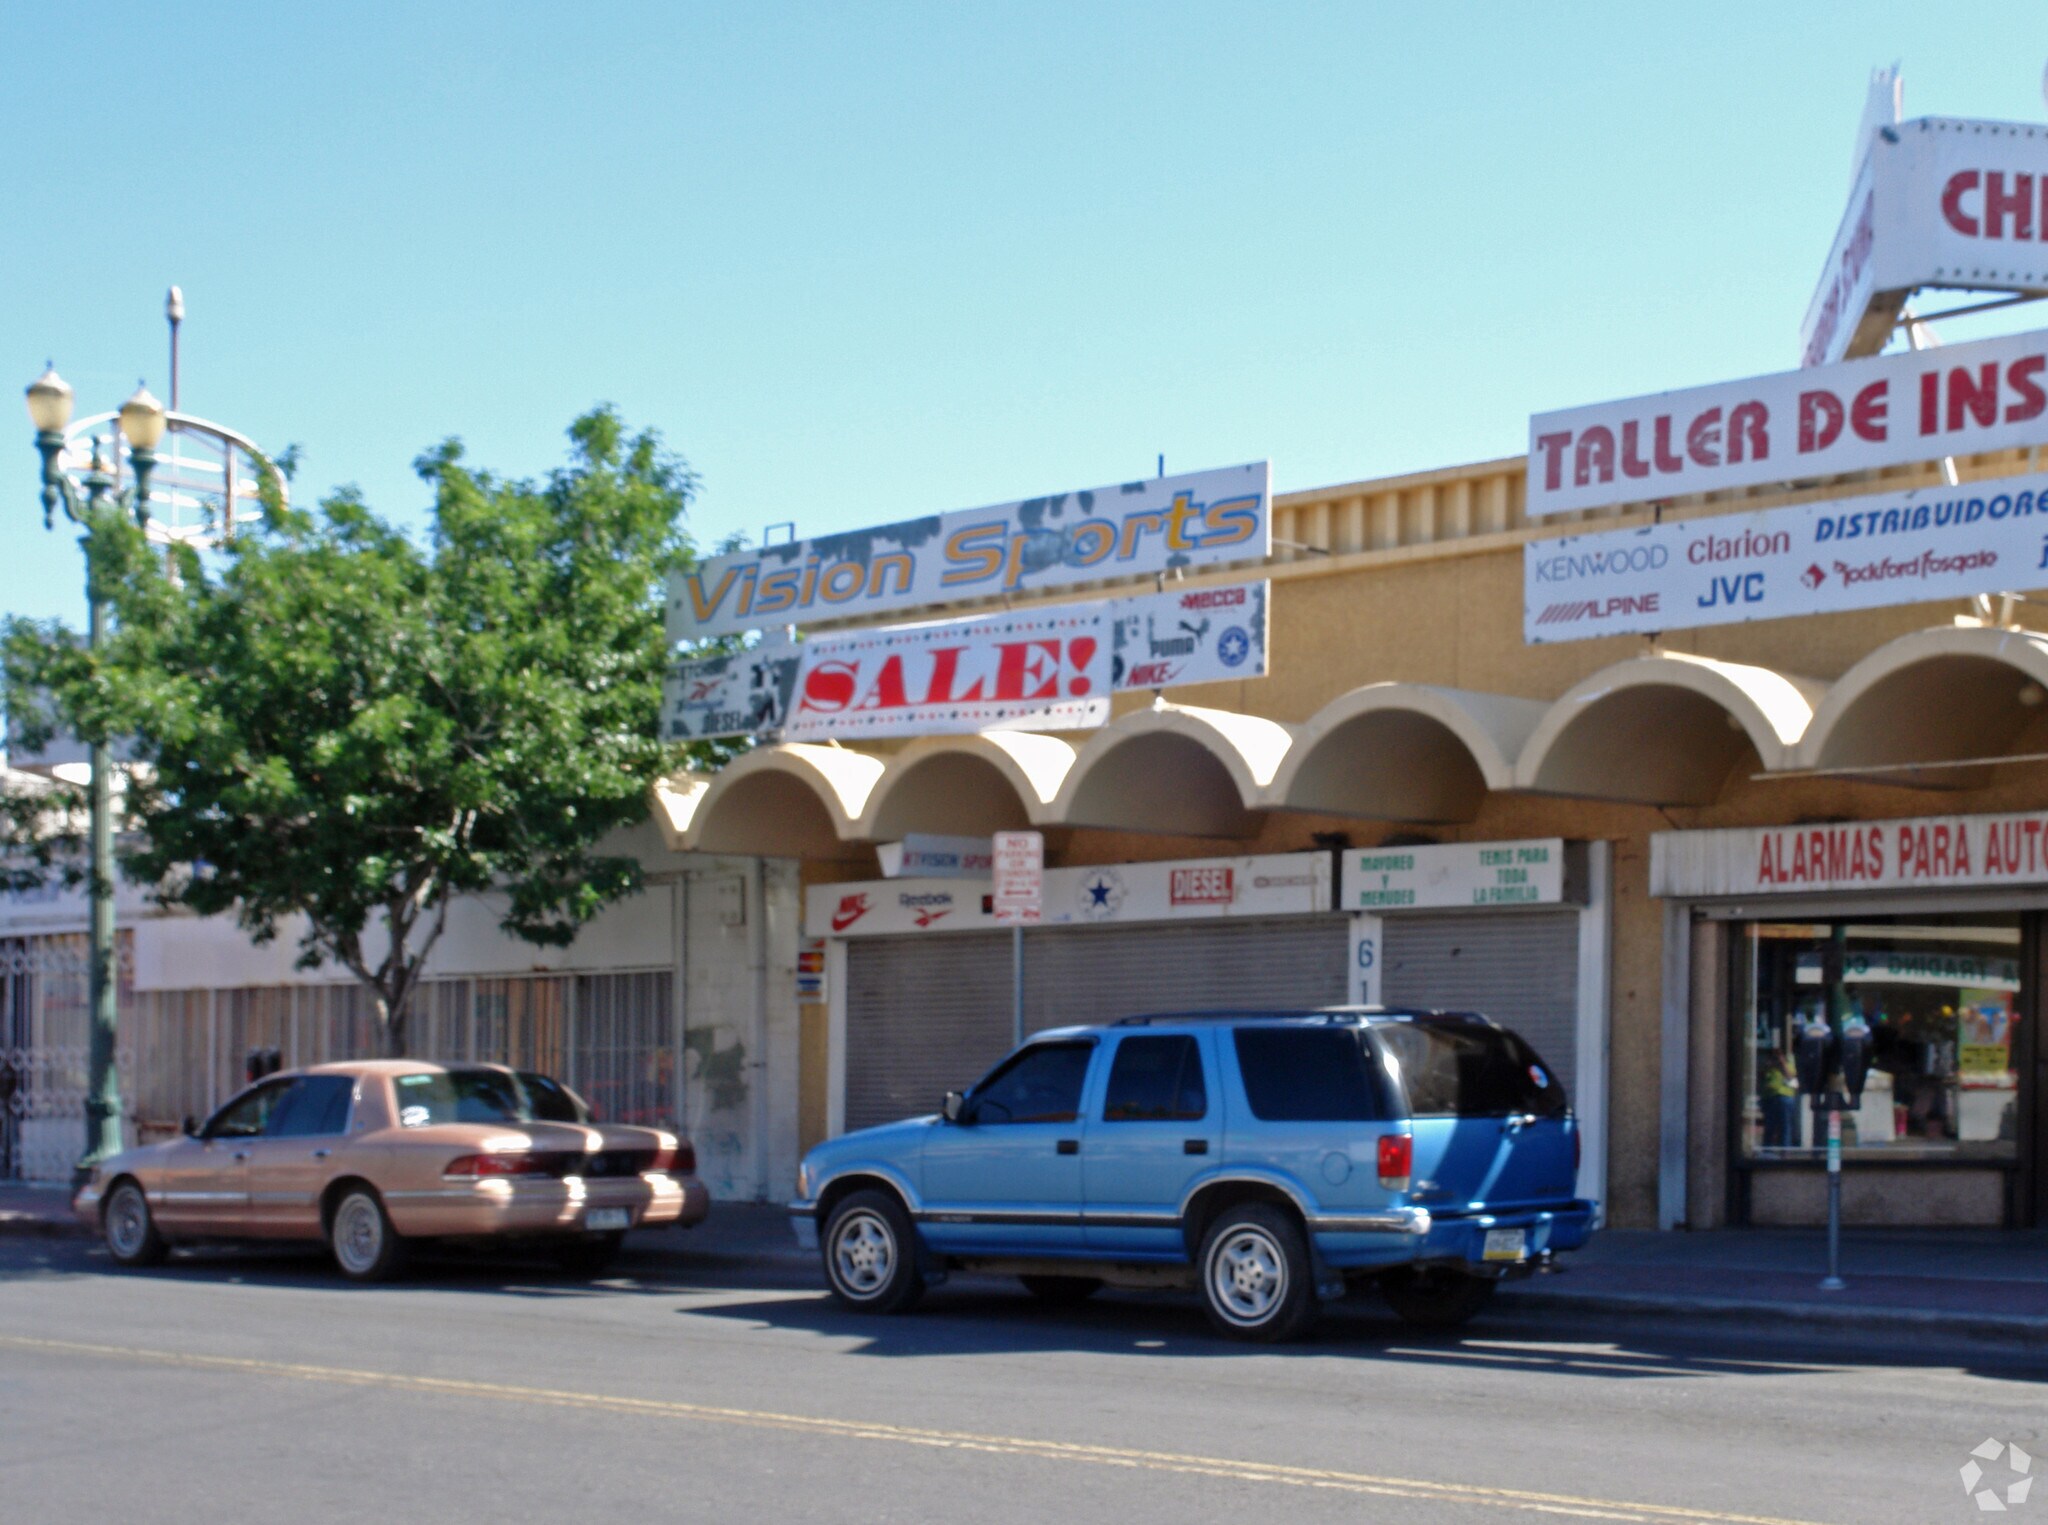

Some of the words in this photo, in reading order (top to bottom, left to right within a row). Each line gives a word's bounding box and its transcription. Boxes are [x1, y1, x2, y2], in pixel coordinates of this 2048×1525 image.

[1537, 399, 1769, 493] TALLER
[1797, 379, 1889, 455] DE
[687, 551, 916, 624] Vision
[940, 489, 1262, 593] Sports
[1535, 545, 1669, 583] KENWOOD
[1567, 593, 1660, 621] ALPINE
[1697, 572, 1764, 608] JVC
[798, 636, 1097, 714] SALE!
[1127, 662, 1171, 686] NIKE
[1361, 854, 1414, 871] MAYOREO
[1480, 849, 1513, 866] TENIS
[1518, 847, 1549, 864] PARA
[1759, 827, 1884, 884] ALARMAS
[1898, 824, 1970, 877] PARA
[1173, 869, 1232, 901] DIESEL
